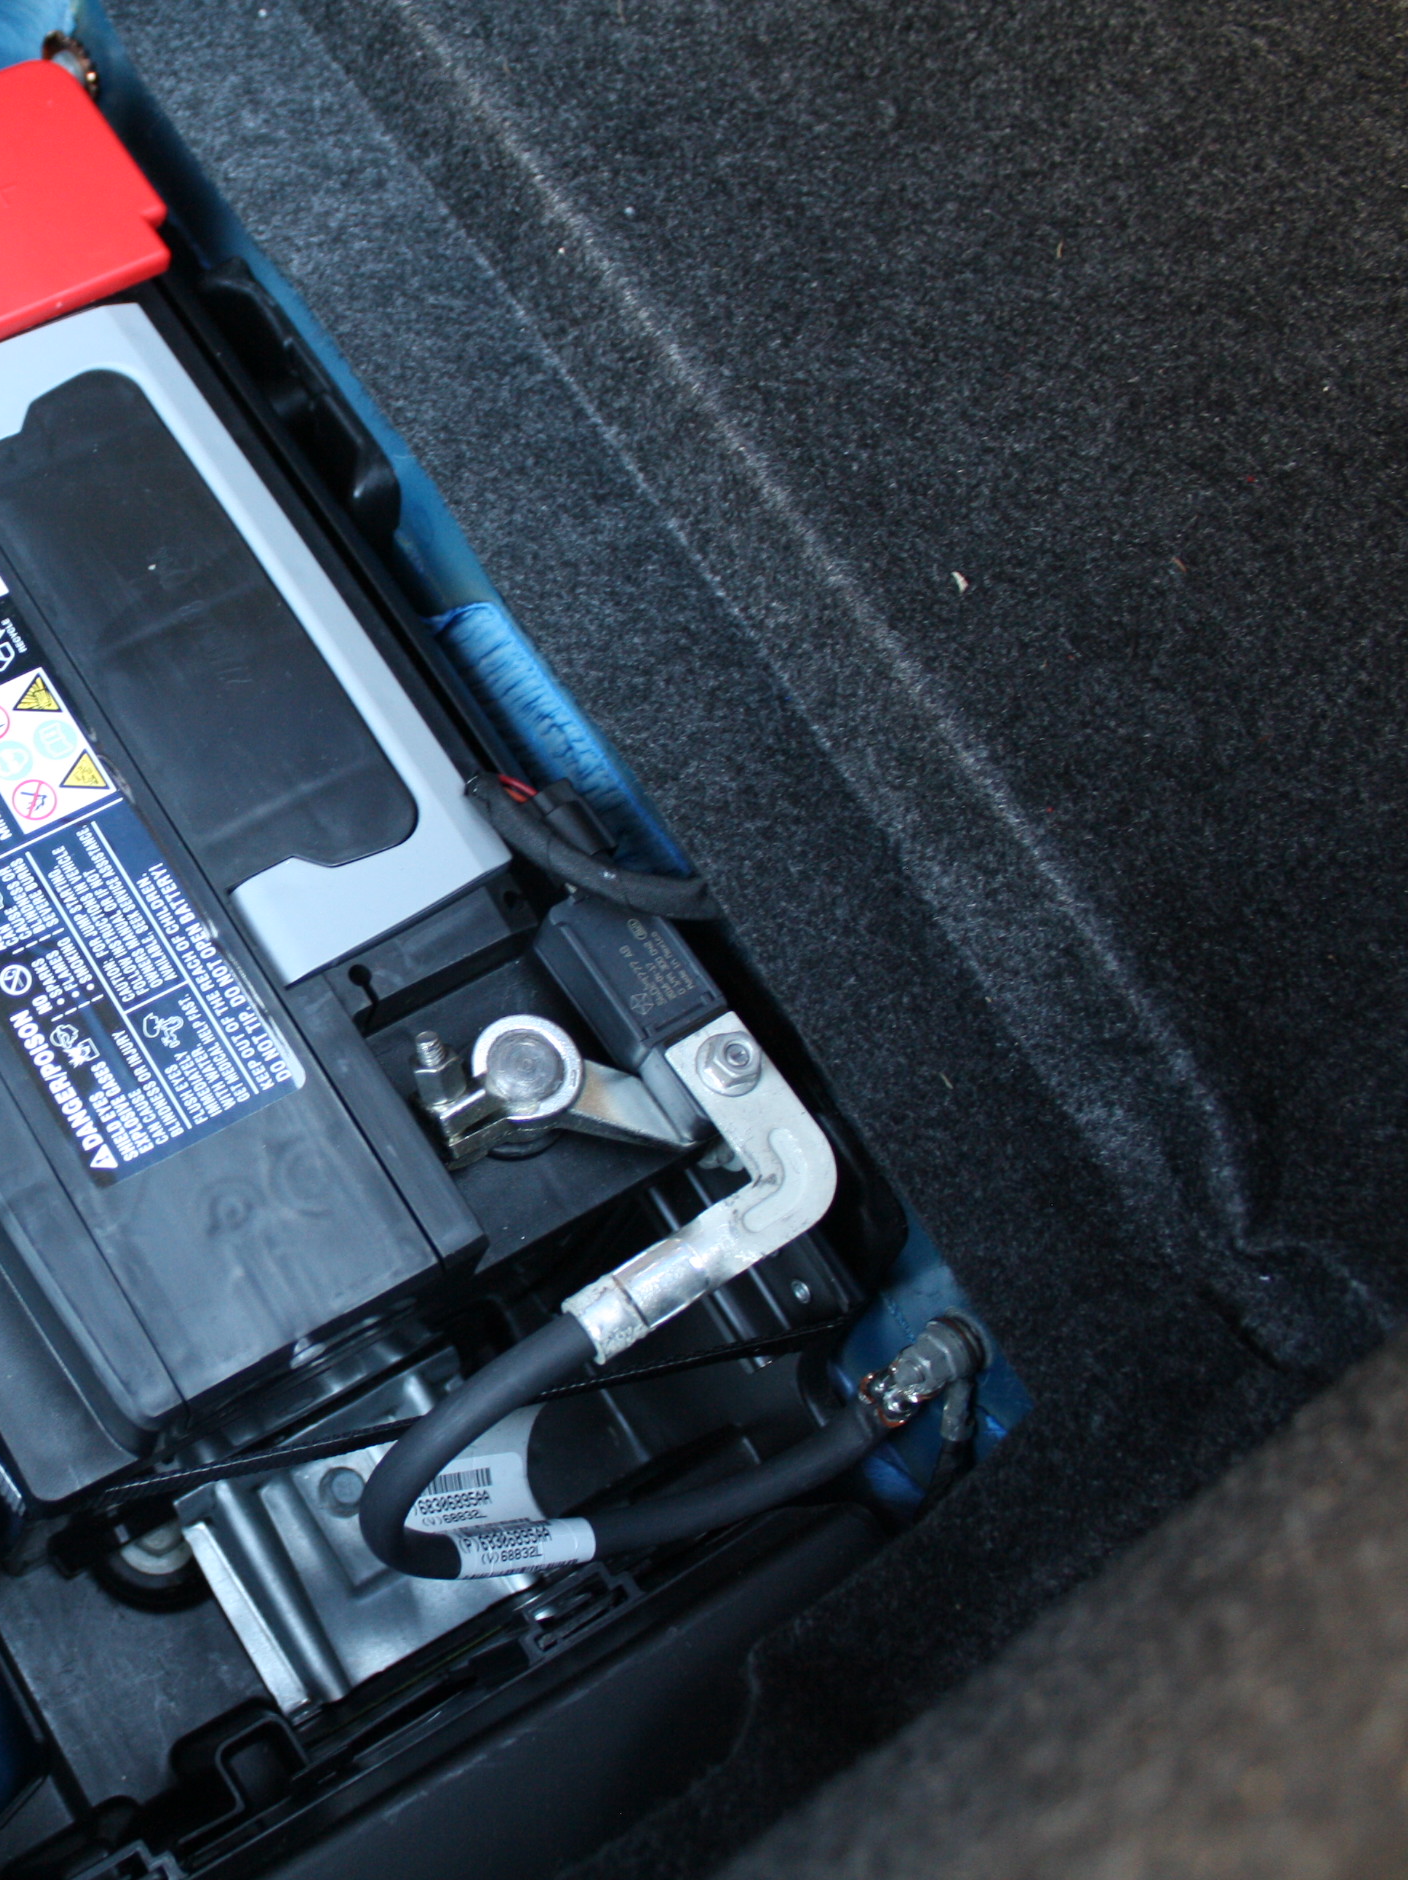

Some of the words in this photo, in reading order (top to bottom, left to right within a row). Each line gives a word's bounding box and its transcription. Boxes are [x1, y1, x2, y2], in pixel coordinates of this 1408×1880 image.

[51, 845, 83, 884] VEHICLE
[75, 824, 115, 878] ASSISTANCE.
[9, 857, 38, 892] BURNS
[73, 882, 89, 894] IN
[82, 868, 103, 889] NOT
[6, 880, 46, 934] BLINDNESS
[28, 889, 59, 927] SEVERE
[94, 887, 109, 898] IF
[100, 896, 117, 912] OR
[105, 876, 136, 913] SERVICE
[134, 872, 180, 934] CHILDREN.
[148, 862, 195, 924] BATTERY!
[4, 905, 32, 940] CAUSE
[72, 912, 98, 938] JUMP
[79, 892, 127, 958] INSTRUCTIONS
[108, 909, 140, 950] MANUAL
[126, 910, 149, 934] SEEK
[88, 936, 109, 958] FOR
[140, 930, 178, 981] AVAILABLE,
[170, 934, 190, 951] OF
[185, 922, 217, 959] OPEN
[650, 930, 673, 959] Mexico
[30, 957, 63, 998] SPARKS
[45, 949, 78, 991] FLAMES
[56, 936, 93, 984] SMOKING
[117, 956, 150, 995] FOLLOW
[131, 947, 163, 988] OWNERS
[181, 950, 214, 992] REACH
[206, 958, 234, 987] NOT
[101, 957, 135, 1002] CAUTION:
[223, 985, 246, 1007] DO
[31, 994, 53, 1014] NO
[177, 994, 201, 1020] FAST.
[205, 990, 229, 1016] THE
[237, 1006, 262, 1033] TIP.
[191, 1019, 215, 1044] HELP
[220, 1015, 240, 1032] OF
[111, 1029, 142, 1067] INJURY
[230, 1032, 256, 1058] OUT
[251, 1031, 280, 1061] NOT
[9, 1009, 105, 1150] DANGER/POISON
[90, 1060, 121, 1097] GASES
[133, 1064, 151, 1082] OR
[163, 1063, 189, 1092] EYES
[189, 1043, 220, 1083] WATER.
[206, 1042, 239, 1084] MEDICAL
[246, 1058, 275, 1090] KEEP
[269, 1058, 293, 1082] DO
[173, 1050, 222, 1117] IMMEDIATELY
[211, 1080, 237, 1110] WITH
[230, 1082, 251, 1102] GET
[88, 1090, 116, 1122] EYES
[127, 1088, 156, 1123] CAUSE
[142, 1080, 184, 1137] BLINDNESS
[179, 1089, 208, 1124] FLUSH
[105, 1119, 139, 1161] SHIELD
[110, 1094, 154, 1153] EXPLOSIVE
[147, 1121, 169, 1144] CAN
